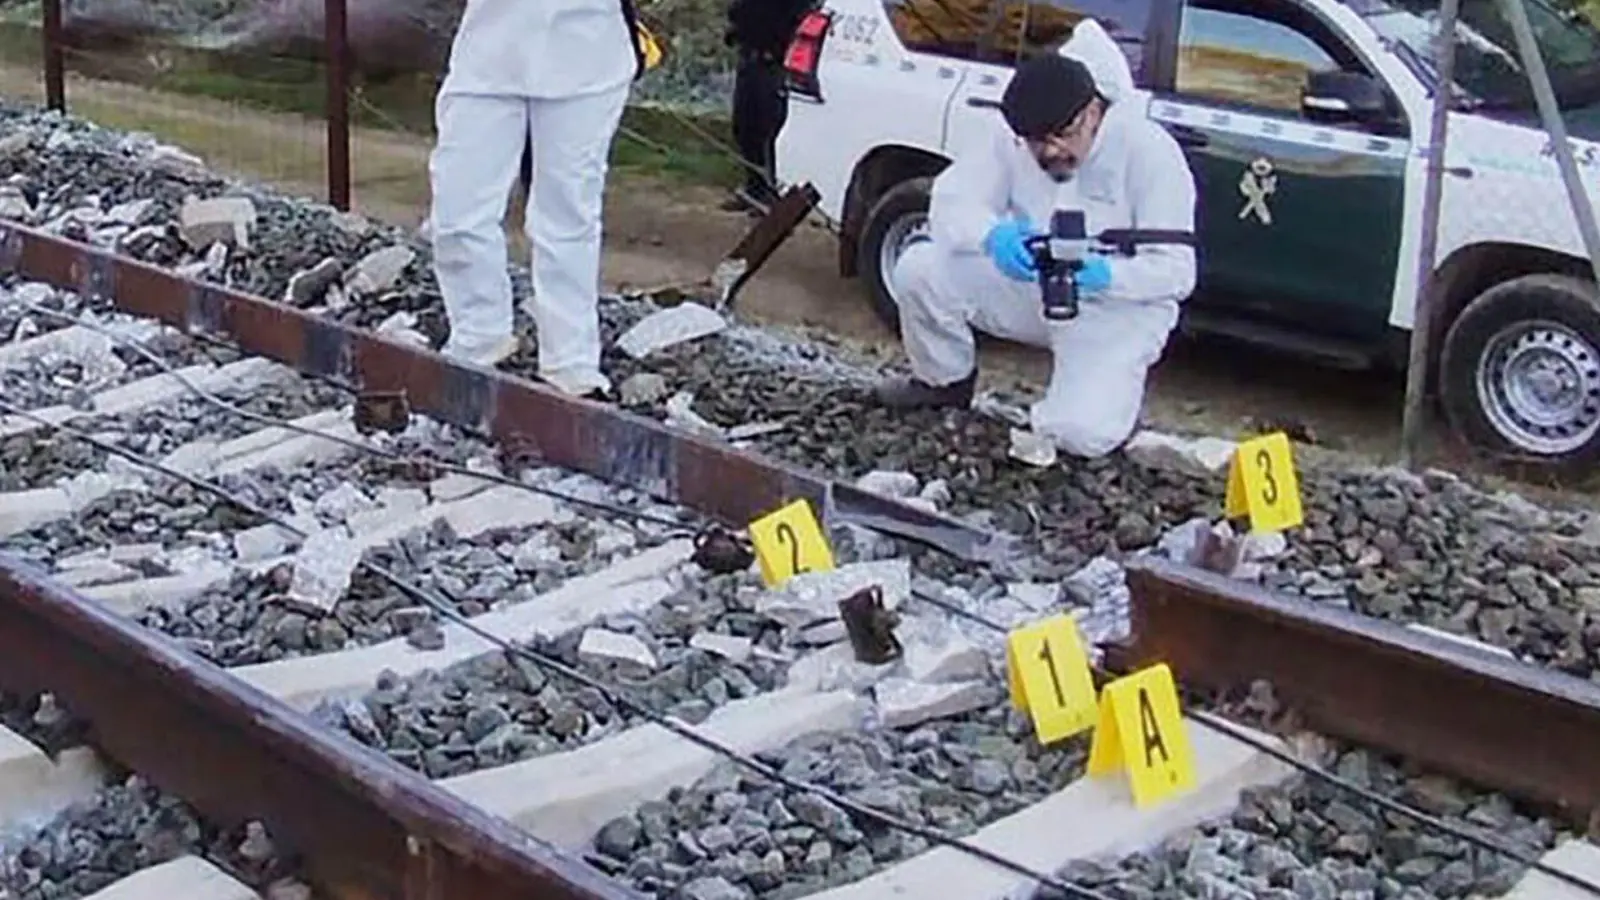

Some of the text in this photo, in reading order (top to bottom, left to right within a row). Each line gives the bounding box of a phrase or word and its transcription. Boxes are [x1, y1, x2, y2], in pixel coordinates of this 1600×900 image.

[1256, 449, 1278, 506] 3
[776, 522, 811, 575] 2
[1039, 638, 1066, 707] 1
[1139, 687, 1169, 767] A
